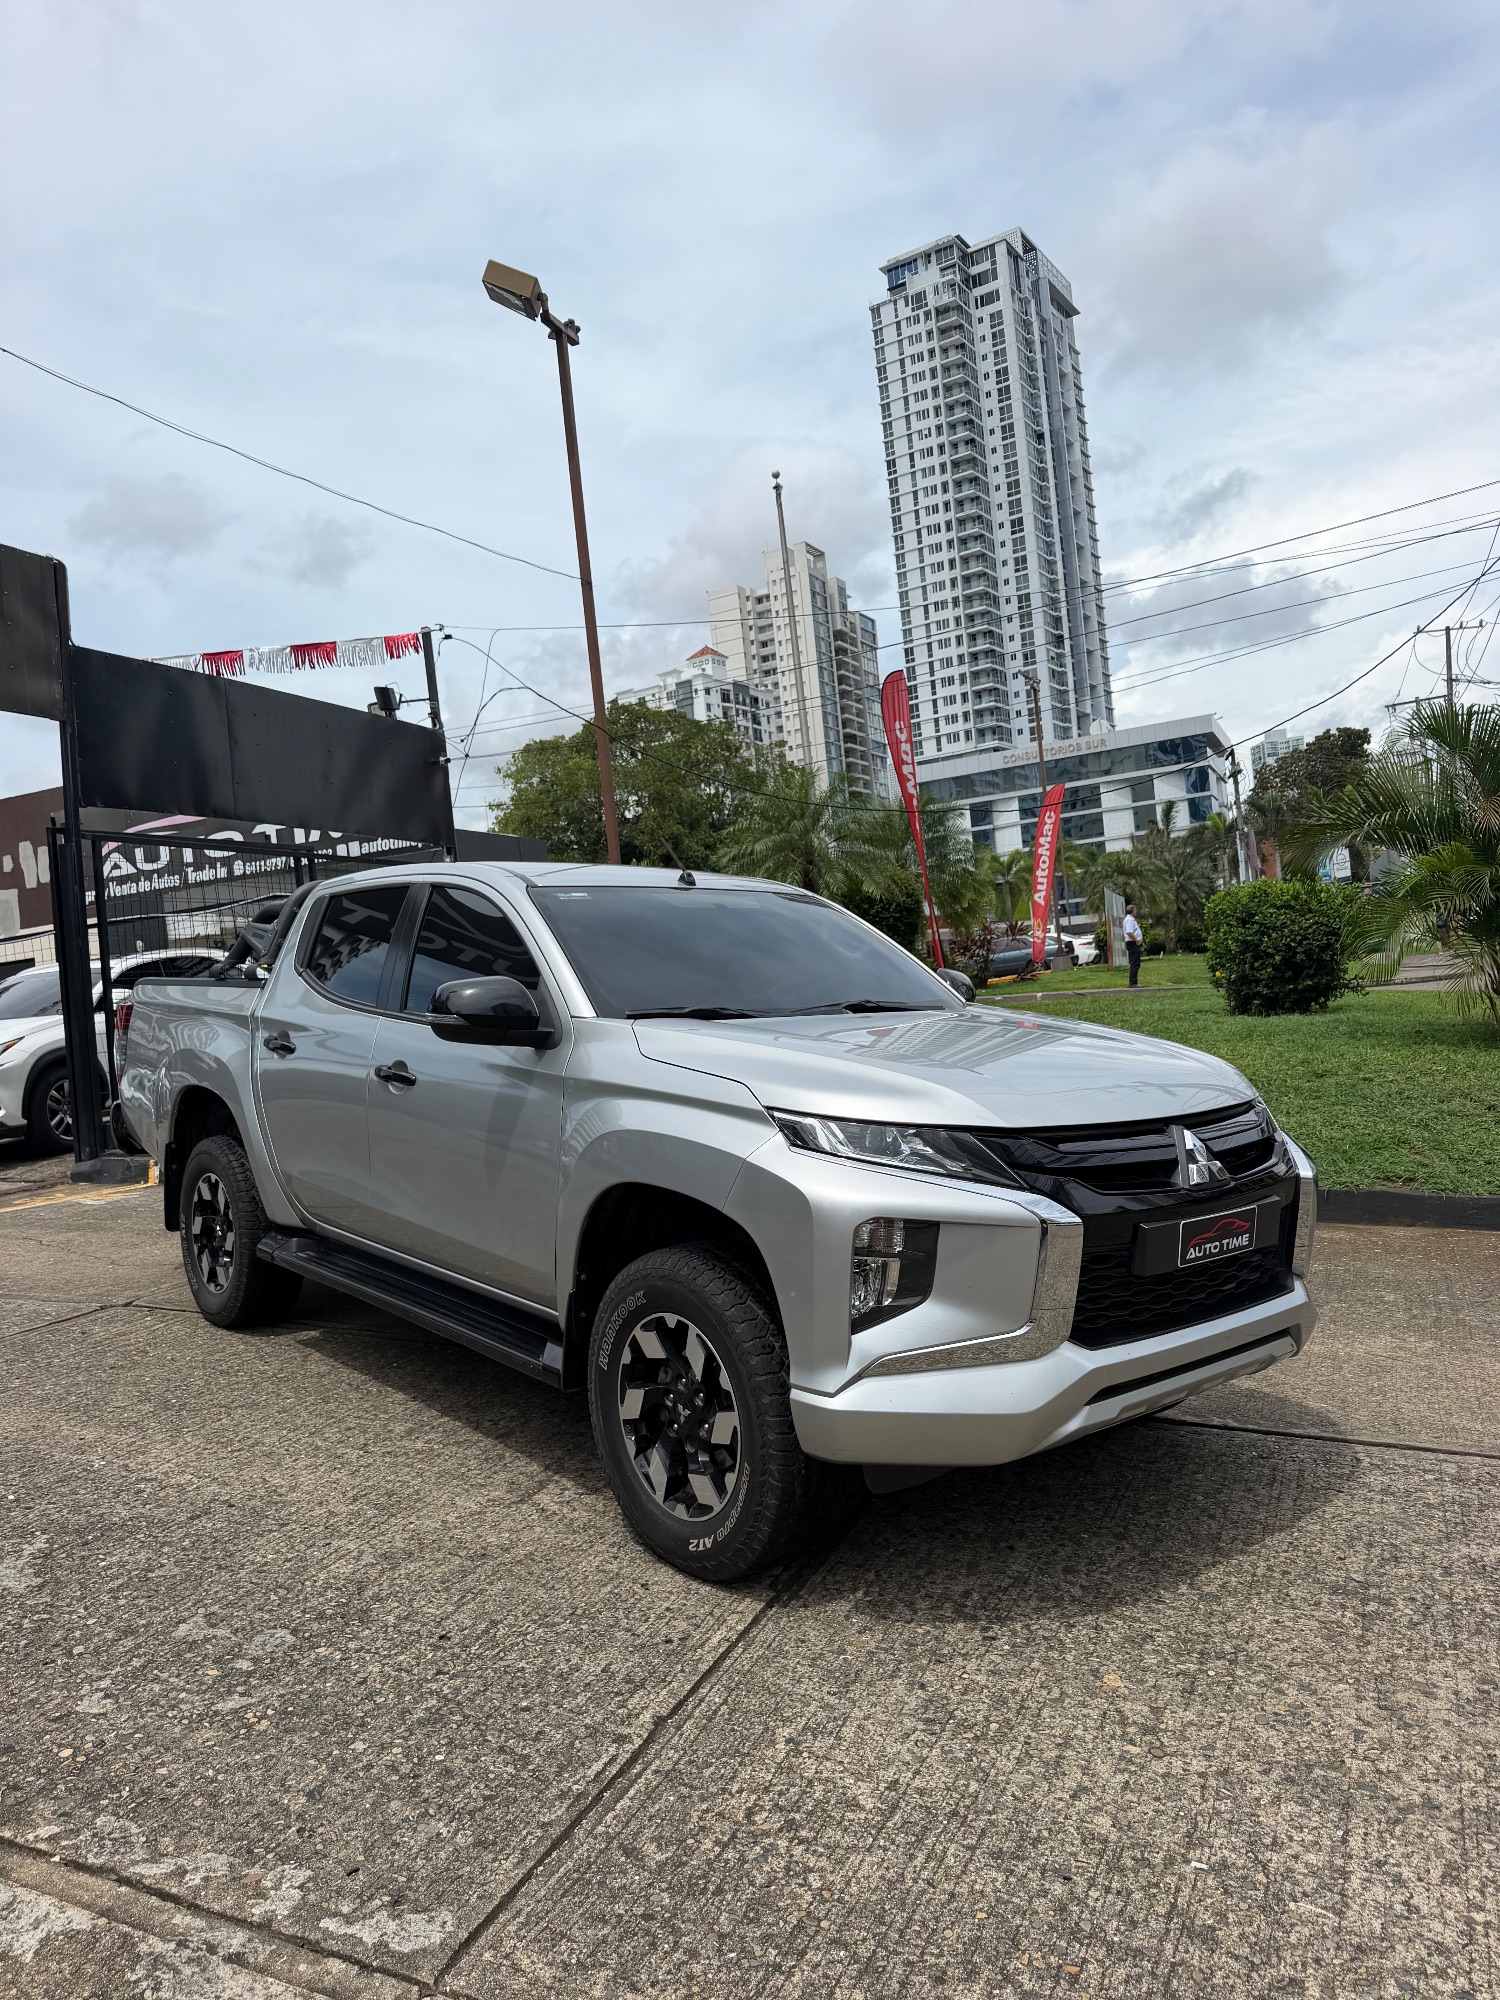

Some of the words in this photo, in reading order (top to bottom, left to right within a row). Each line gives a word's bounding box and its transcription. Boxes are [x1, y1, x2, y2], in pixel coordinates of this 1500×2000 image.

[1002, 743, 1083, 764] CONSUTORIOS
[1085, 738, 1108, 750] SUR
[1033, 810, 1056, 906] AutoMac
[109, 880, 137, 897] Venta
[138, 876, 150, 892] de
[151, 873, 180, 891] Autos
[186, 864, 215, 884] Trade
[1185, 1241, 1220, 1259] AUTO
[1221, 1233, 1250, 1250] TIME
[688, 1534, 714, 1551] AT2
